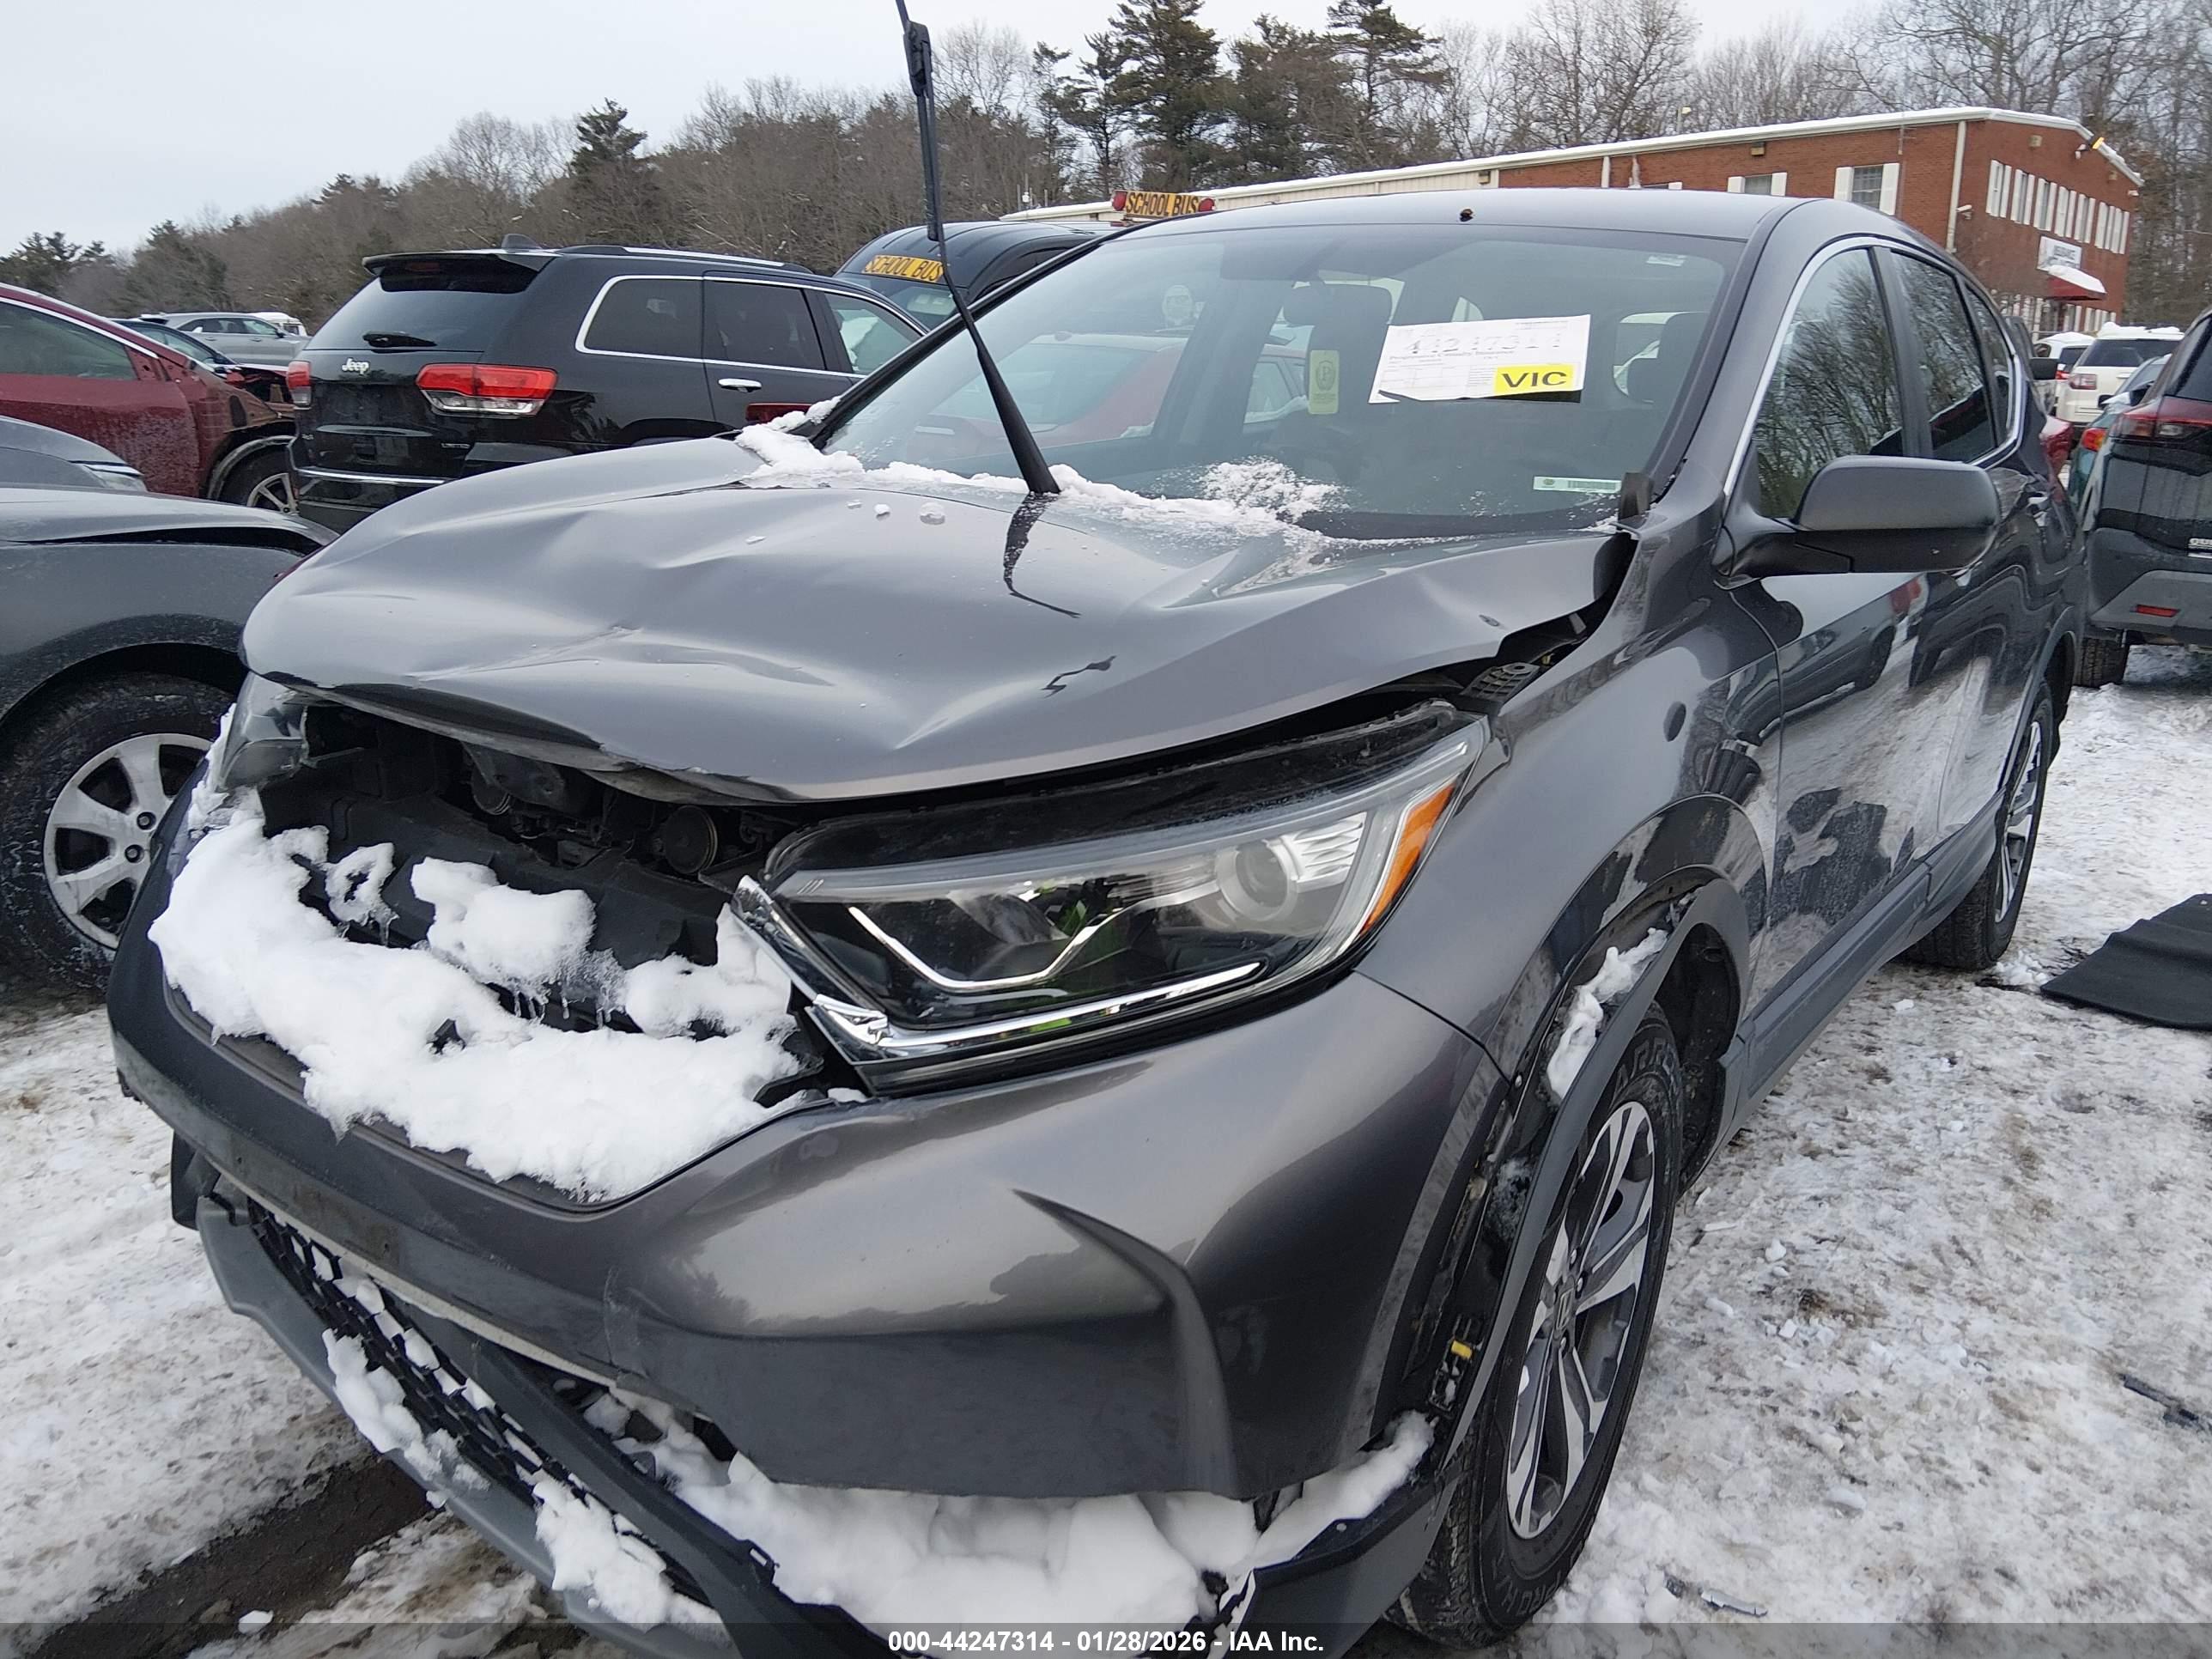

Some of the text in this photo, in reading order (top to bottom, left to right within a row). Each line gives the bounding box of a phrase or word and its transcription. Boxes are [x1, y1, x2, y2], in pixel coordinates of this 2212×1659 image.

[1126, 191, 1199, 216] SCHOOL BUS
[865, 256, 942, 281] SCHOOL BUS
[341, 357, 369, 375] Jeep
[1502, 371, 1567, 387] VIC
